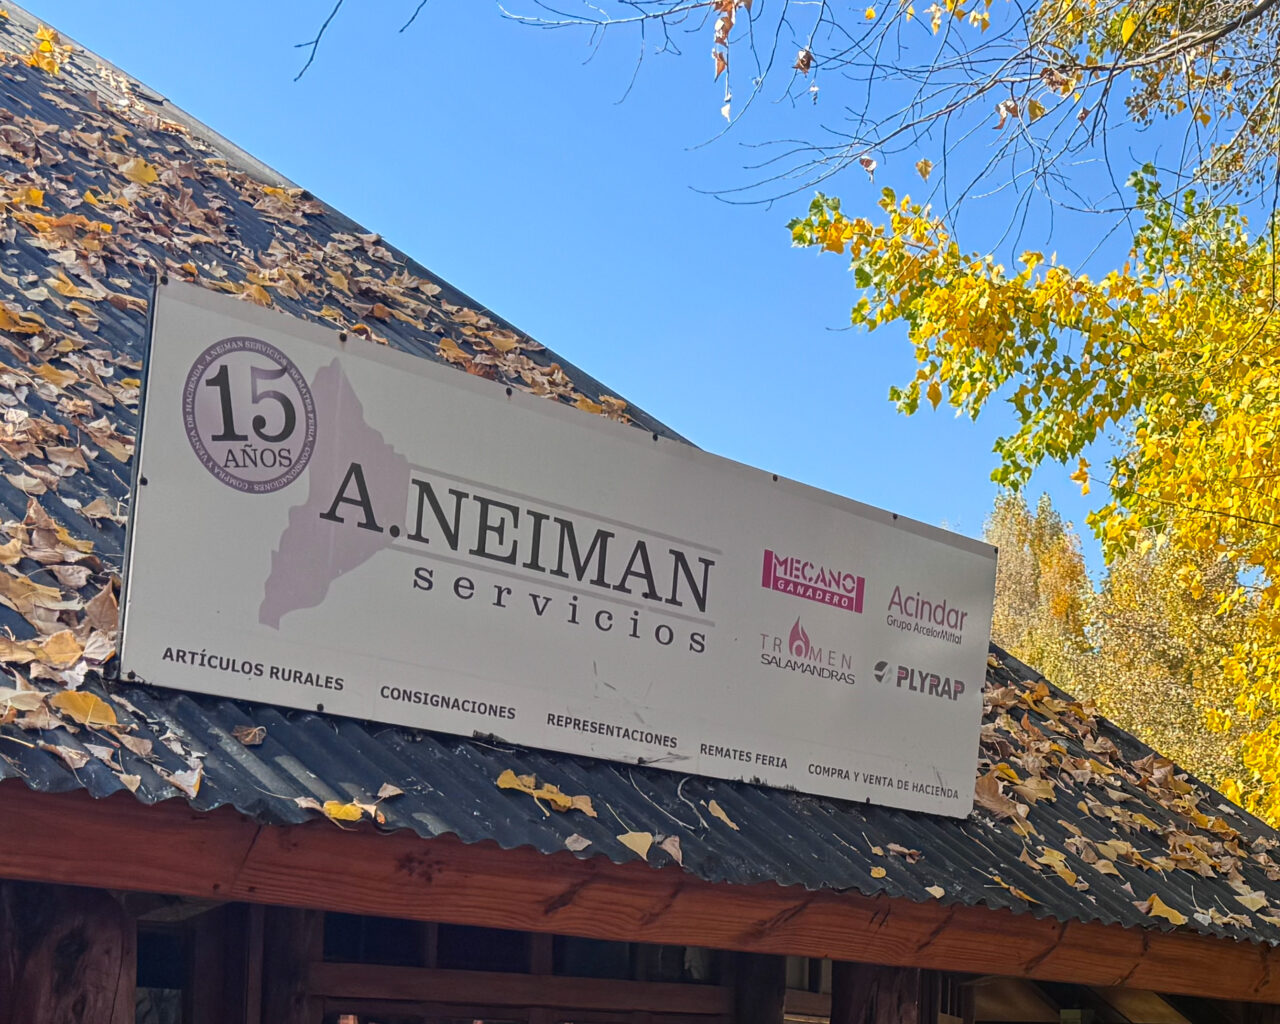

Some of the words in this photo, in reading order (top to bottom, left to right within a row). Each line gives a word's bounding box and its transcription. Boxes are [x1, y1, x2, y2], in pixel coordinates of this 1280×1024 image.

[244, 340, 288, 367] SERVICIOS
[186, 364, 204, 412] HACIENDA
[205, 364, 297, 443] 15
[289, 367, 313, 411] REMATES
[189, 430, 207, 462] VENTA
[223, 444, 293, 468] AÑOS
[214, 465, 249, 490] COMPRA
[254, 447, 312, 491] CONSIGNACIONES
[319, 462, 716, 613] A.NEIMAN
[773, 553, 856, 594] MECANO
[413, 565, 707, 654] servicios
[777, 580, 849, 607] GANADERO
[888, 585, 968, 631] Acindar
[887, 614, 912, 632] Grupo
[913, 622, 962, 645] ArcelorMittal
[162, 647, 264, 677] ARTÍCULOS
[270, 666, 344, 691] RURALES
[761, 653, 855, 685] SALAMANDRAS
[896, 665, 965, 701] PLYRAP
[380, 685, 516, 720] CONSIGNACIONES
[547, 713, 678, 749] REPRESENTACIONES
[700, 743, 752, 763] REMATES
[755, 754, 788, 769] FERIA
[808, 763, 850, 781] COMPRA
[853, 771, 860, 782] Y
[863, 773, 894, 789] VENTA
[897, 779, 909, 791] DE
[912, 782, 959, 800] HACIENDA
